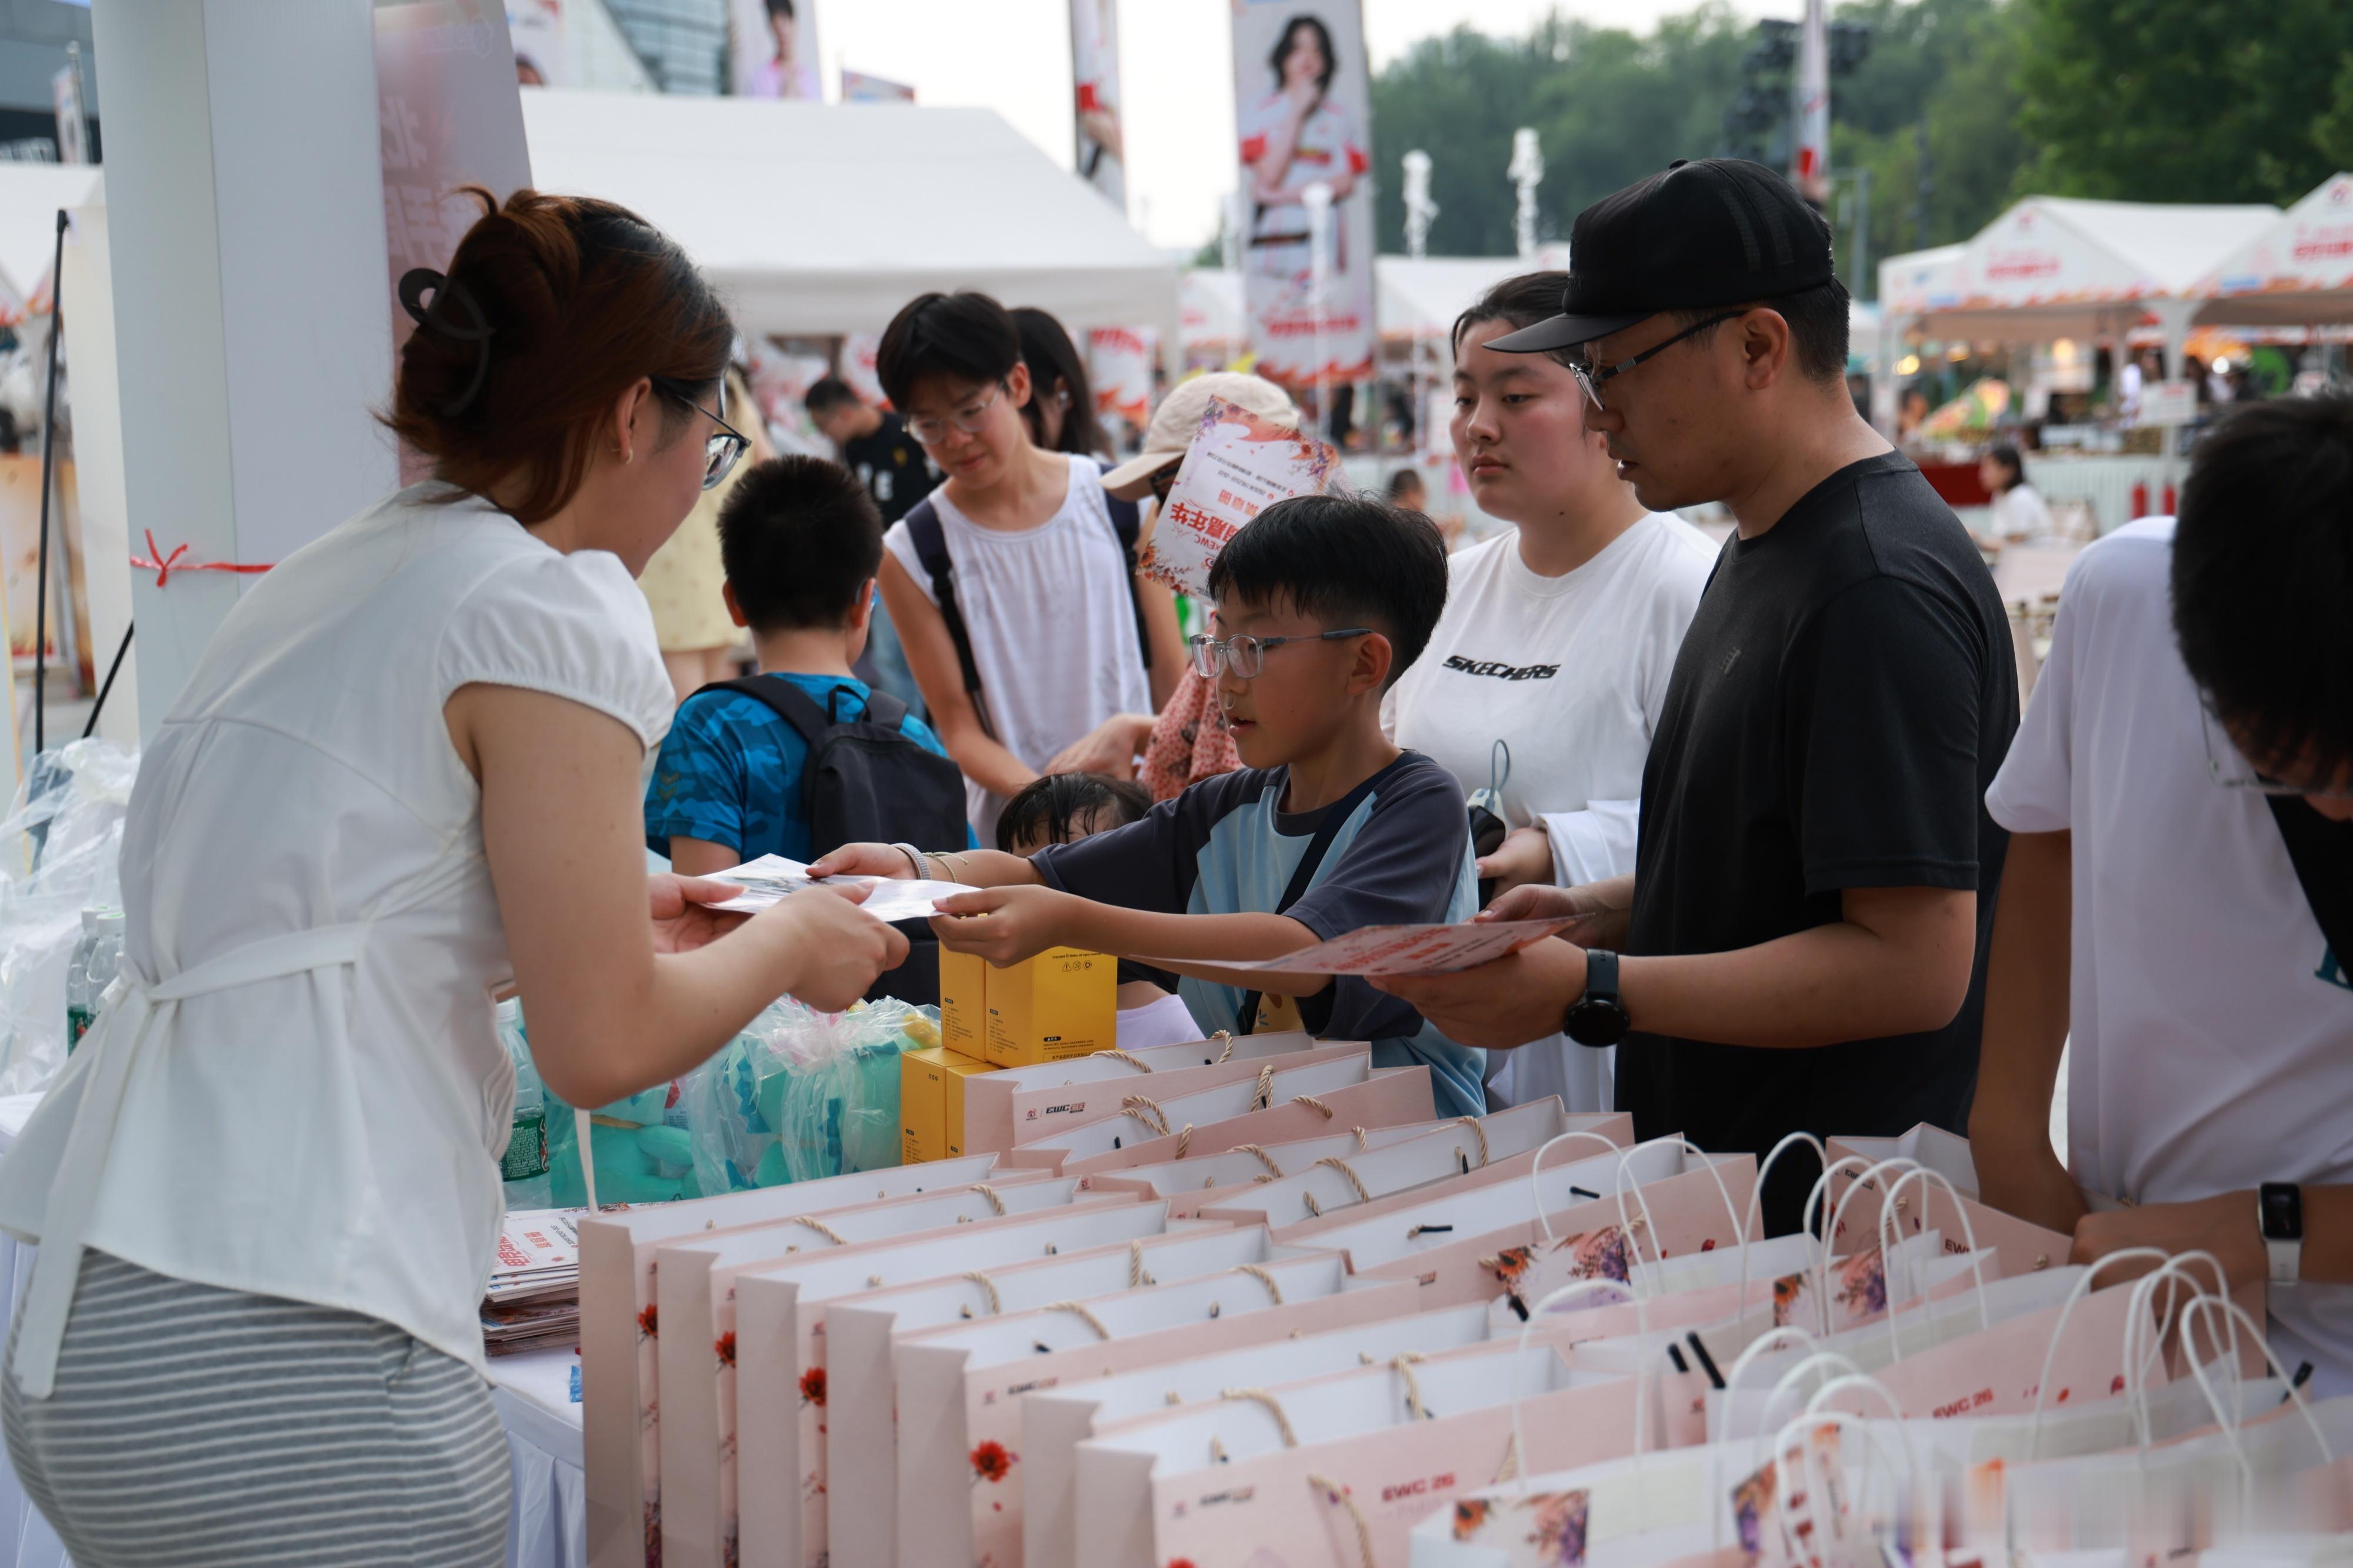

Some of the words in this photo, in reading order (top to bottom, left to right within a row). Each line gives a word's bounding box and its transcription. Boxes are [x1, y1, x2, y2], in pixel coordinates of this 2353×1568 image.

[1442, 655, 1561, 680] SKECHERS
[1382, 1478, 1427, 1502] EWC
[1431, 1472, 1456, 1491] 26
